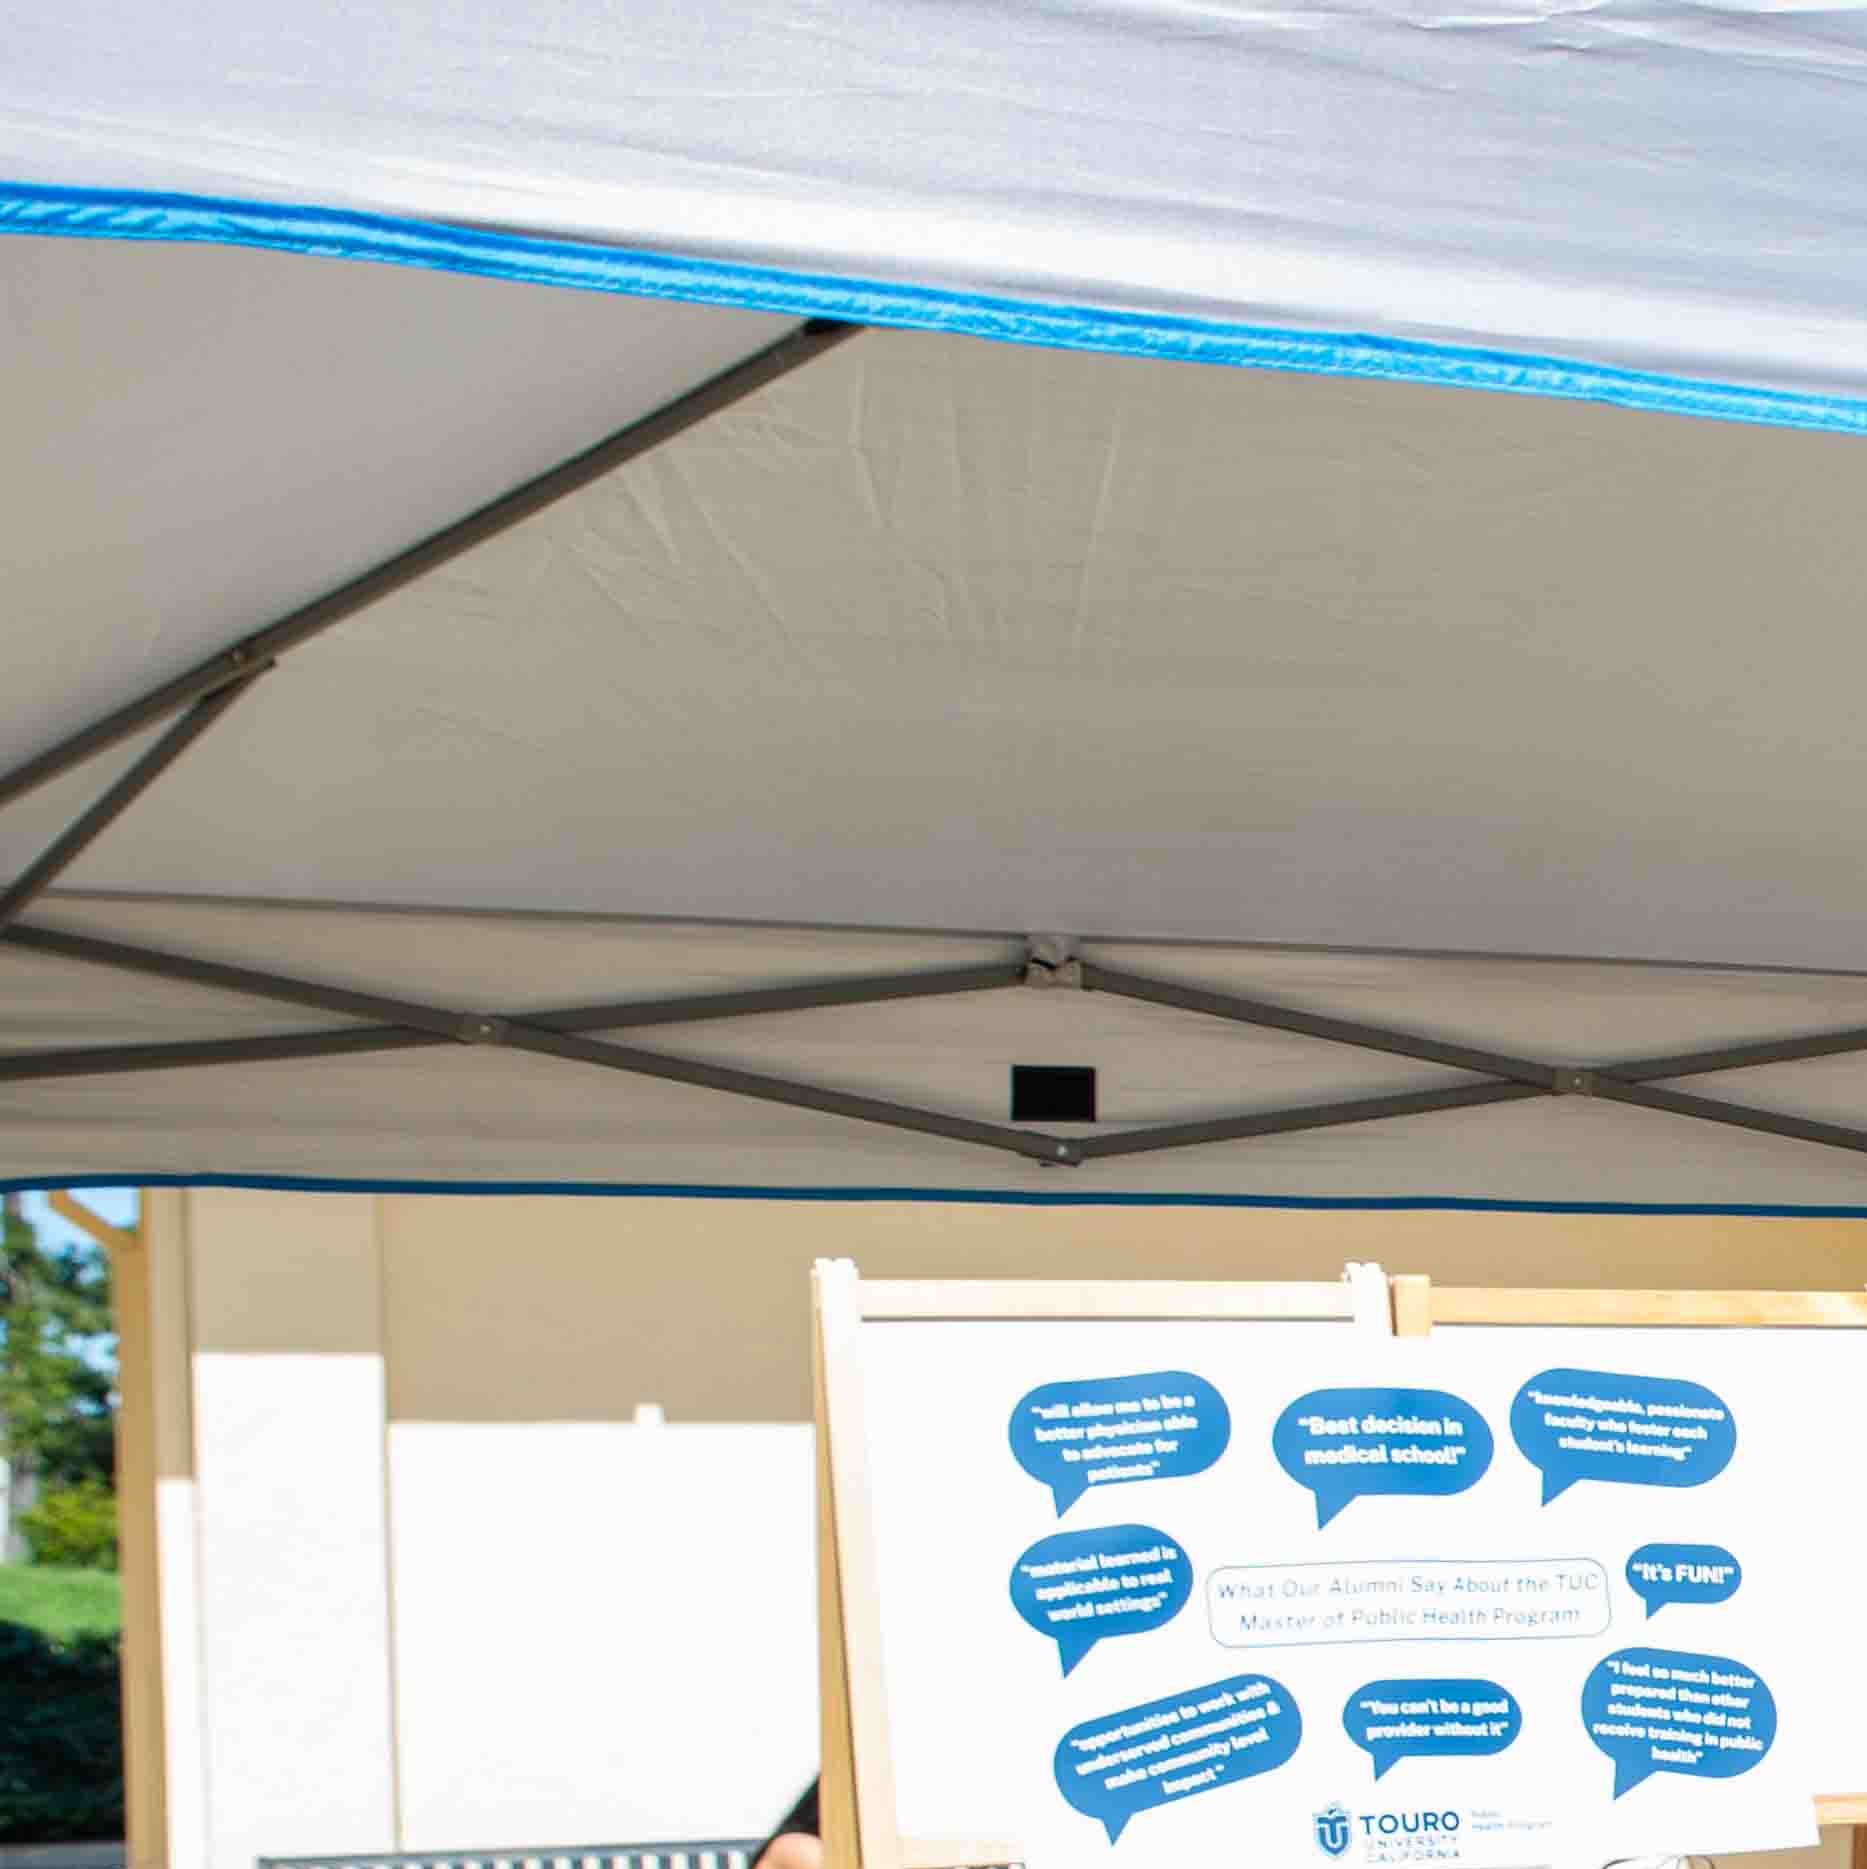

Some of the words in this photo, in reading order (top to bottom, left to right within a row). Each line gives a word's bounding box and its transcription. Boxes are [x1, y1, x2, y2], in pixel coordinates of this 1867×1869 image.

[1362, 1416, 1440, 1435] decision
[1444, 1417, 1462, 1435] in
[1304, 1446, 1387, 1465] medical
[1453, 1575, 1510, 1594] About
[1517, 1575, 1551, 1594] the
[1557, 1573, 1599, 1591] TUC
[1352, 1610, 1415, 1628] Public
[1422, 1608, 1488, 1626] Health
[1494, 1606, 1581, 1629] Program
[1361, 1810, 1460, 1835] TOURO
